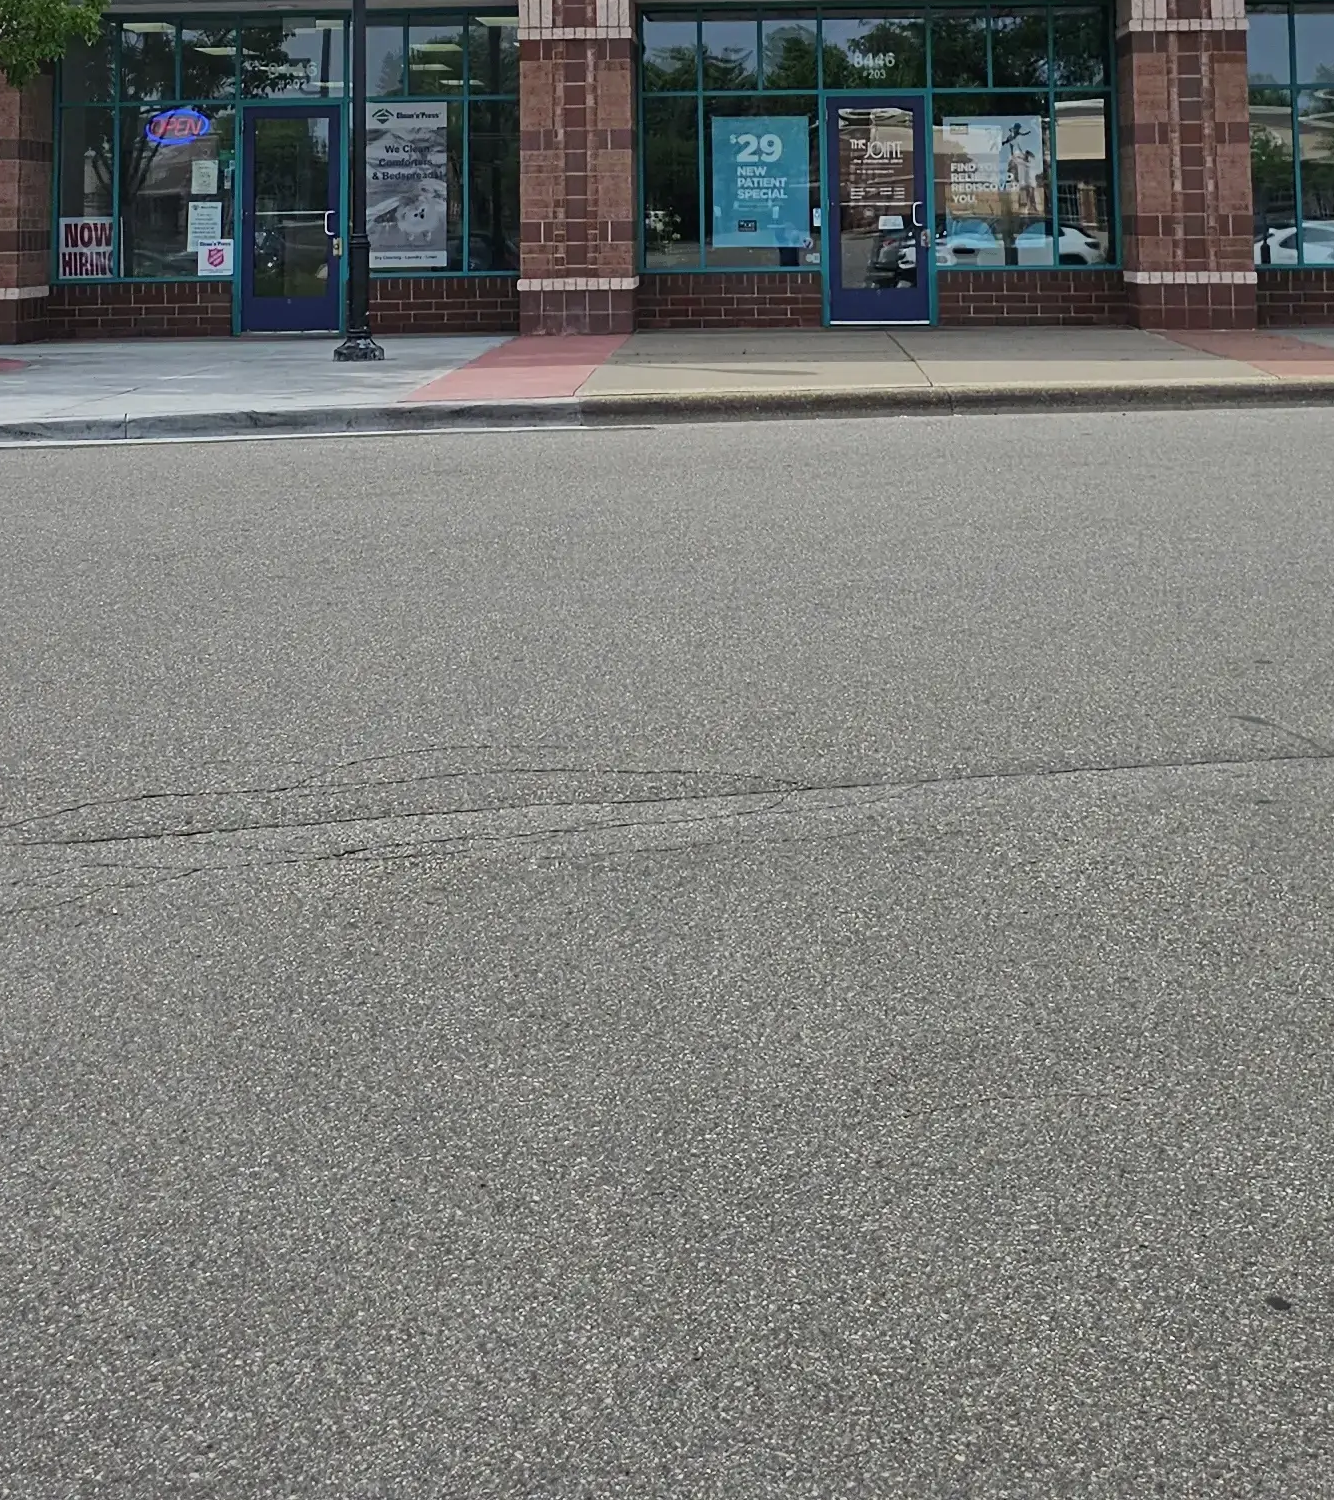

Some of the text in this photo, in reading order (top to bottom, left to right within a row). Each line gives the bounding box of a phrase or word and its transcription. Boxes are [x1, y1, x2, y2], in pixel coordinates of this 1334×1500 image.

[853, 51, 896, 68] 8446
[151, 118, 202, 136] OPEN
[384, 145, 430, 154] We Clean
[730, 133, 782, 163] $29
[864, 141, 903, 159] JOINT
[378, 158, 433, 168] Comforters
[950, 162, 977, 172] FIND
[371, 171, 380, 180] &
[737, 166, 767, 176] NEW
[737, 177, 788, 188] PATIENT
[737, 189, 788, 199] SPECIAL
[64, 222, 113, 248] NOW
